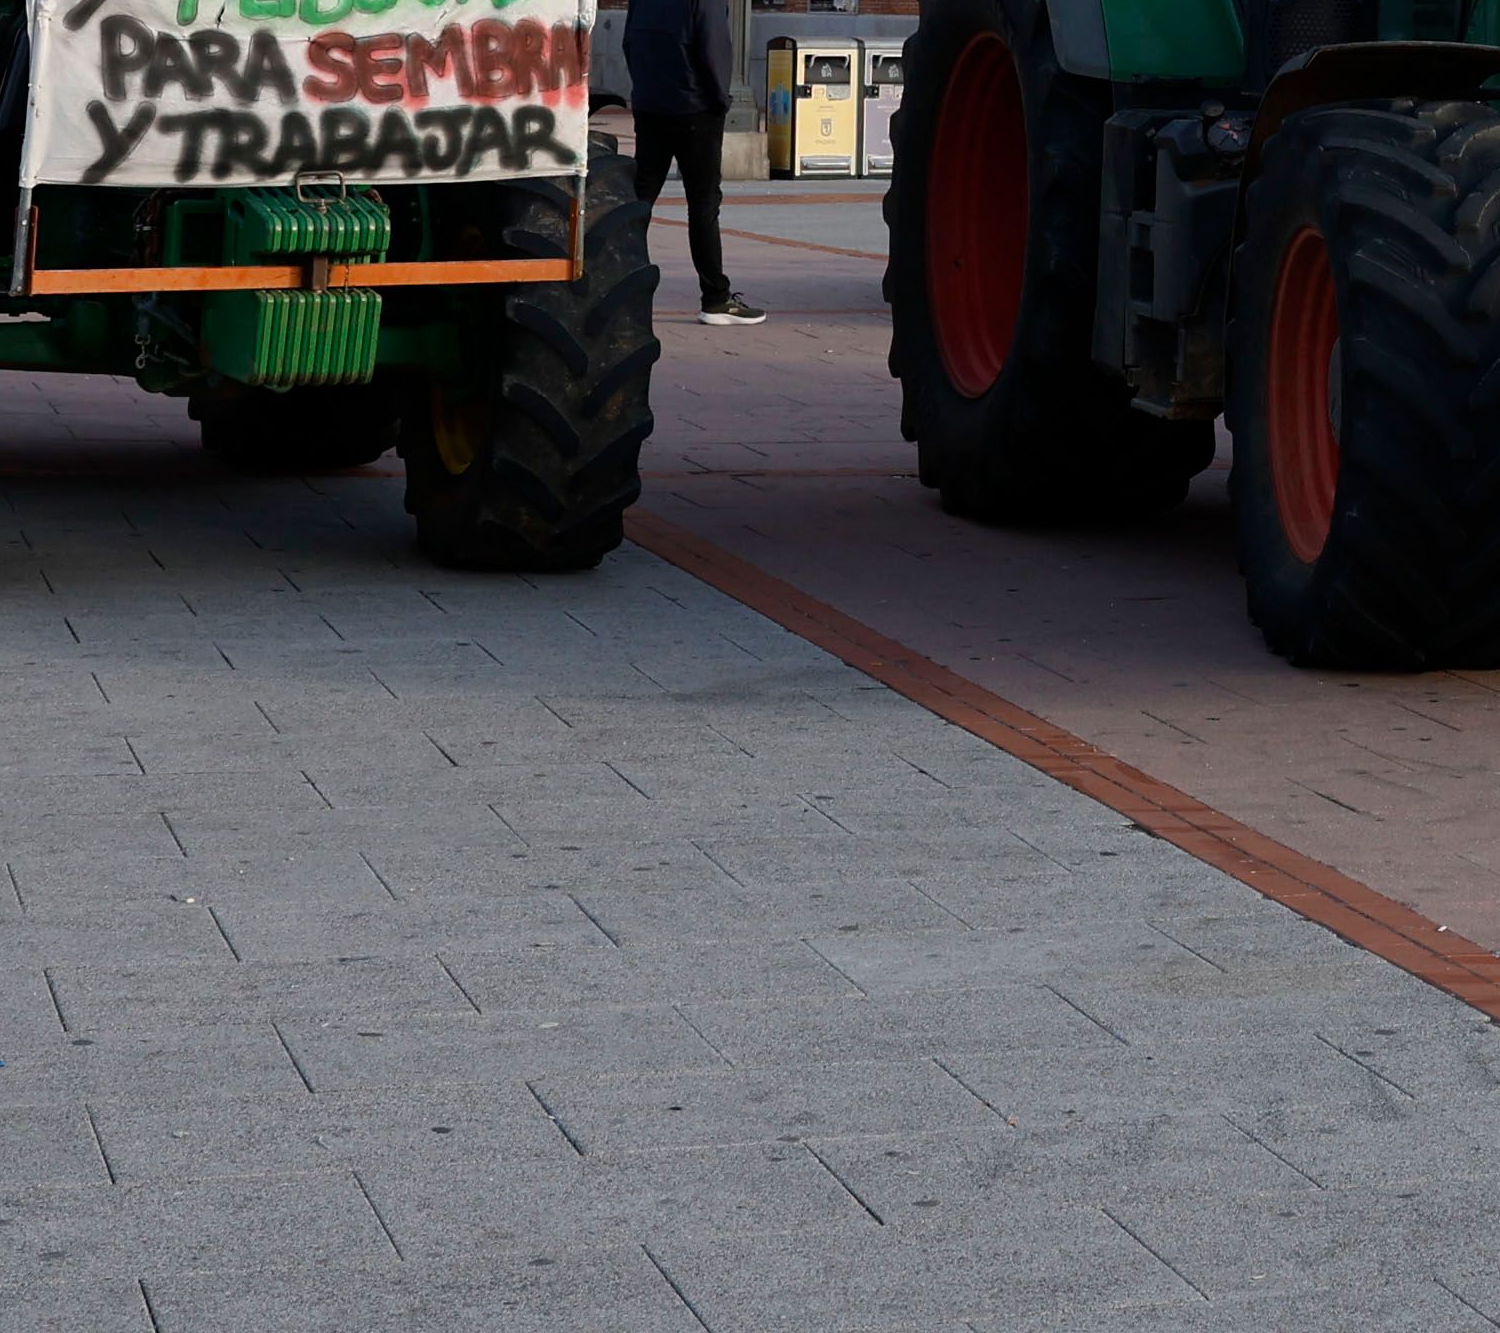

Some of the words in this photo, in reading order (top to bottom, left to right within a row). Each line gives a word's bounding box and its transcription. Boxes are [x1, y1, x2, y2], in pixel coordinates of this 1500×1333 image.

[100, 14, 296, 102] PARA
[85, 100, 157, 184] Y
[158, 105, 583, 183] TRABAJAR
